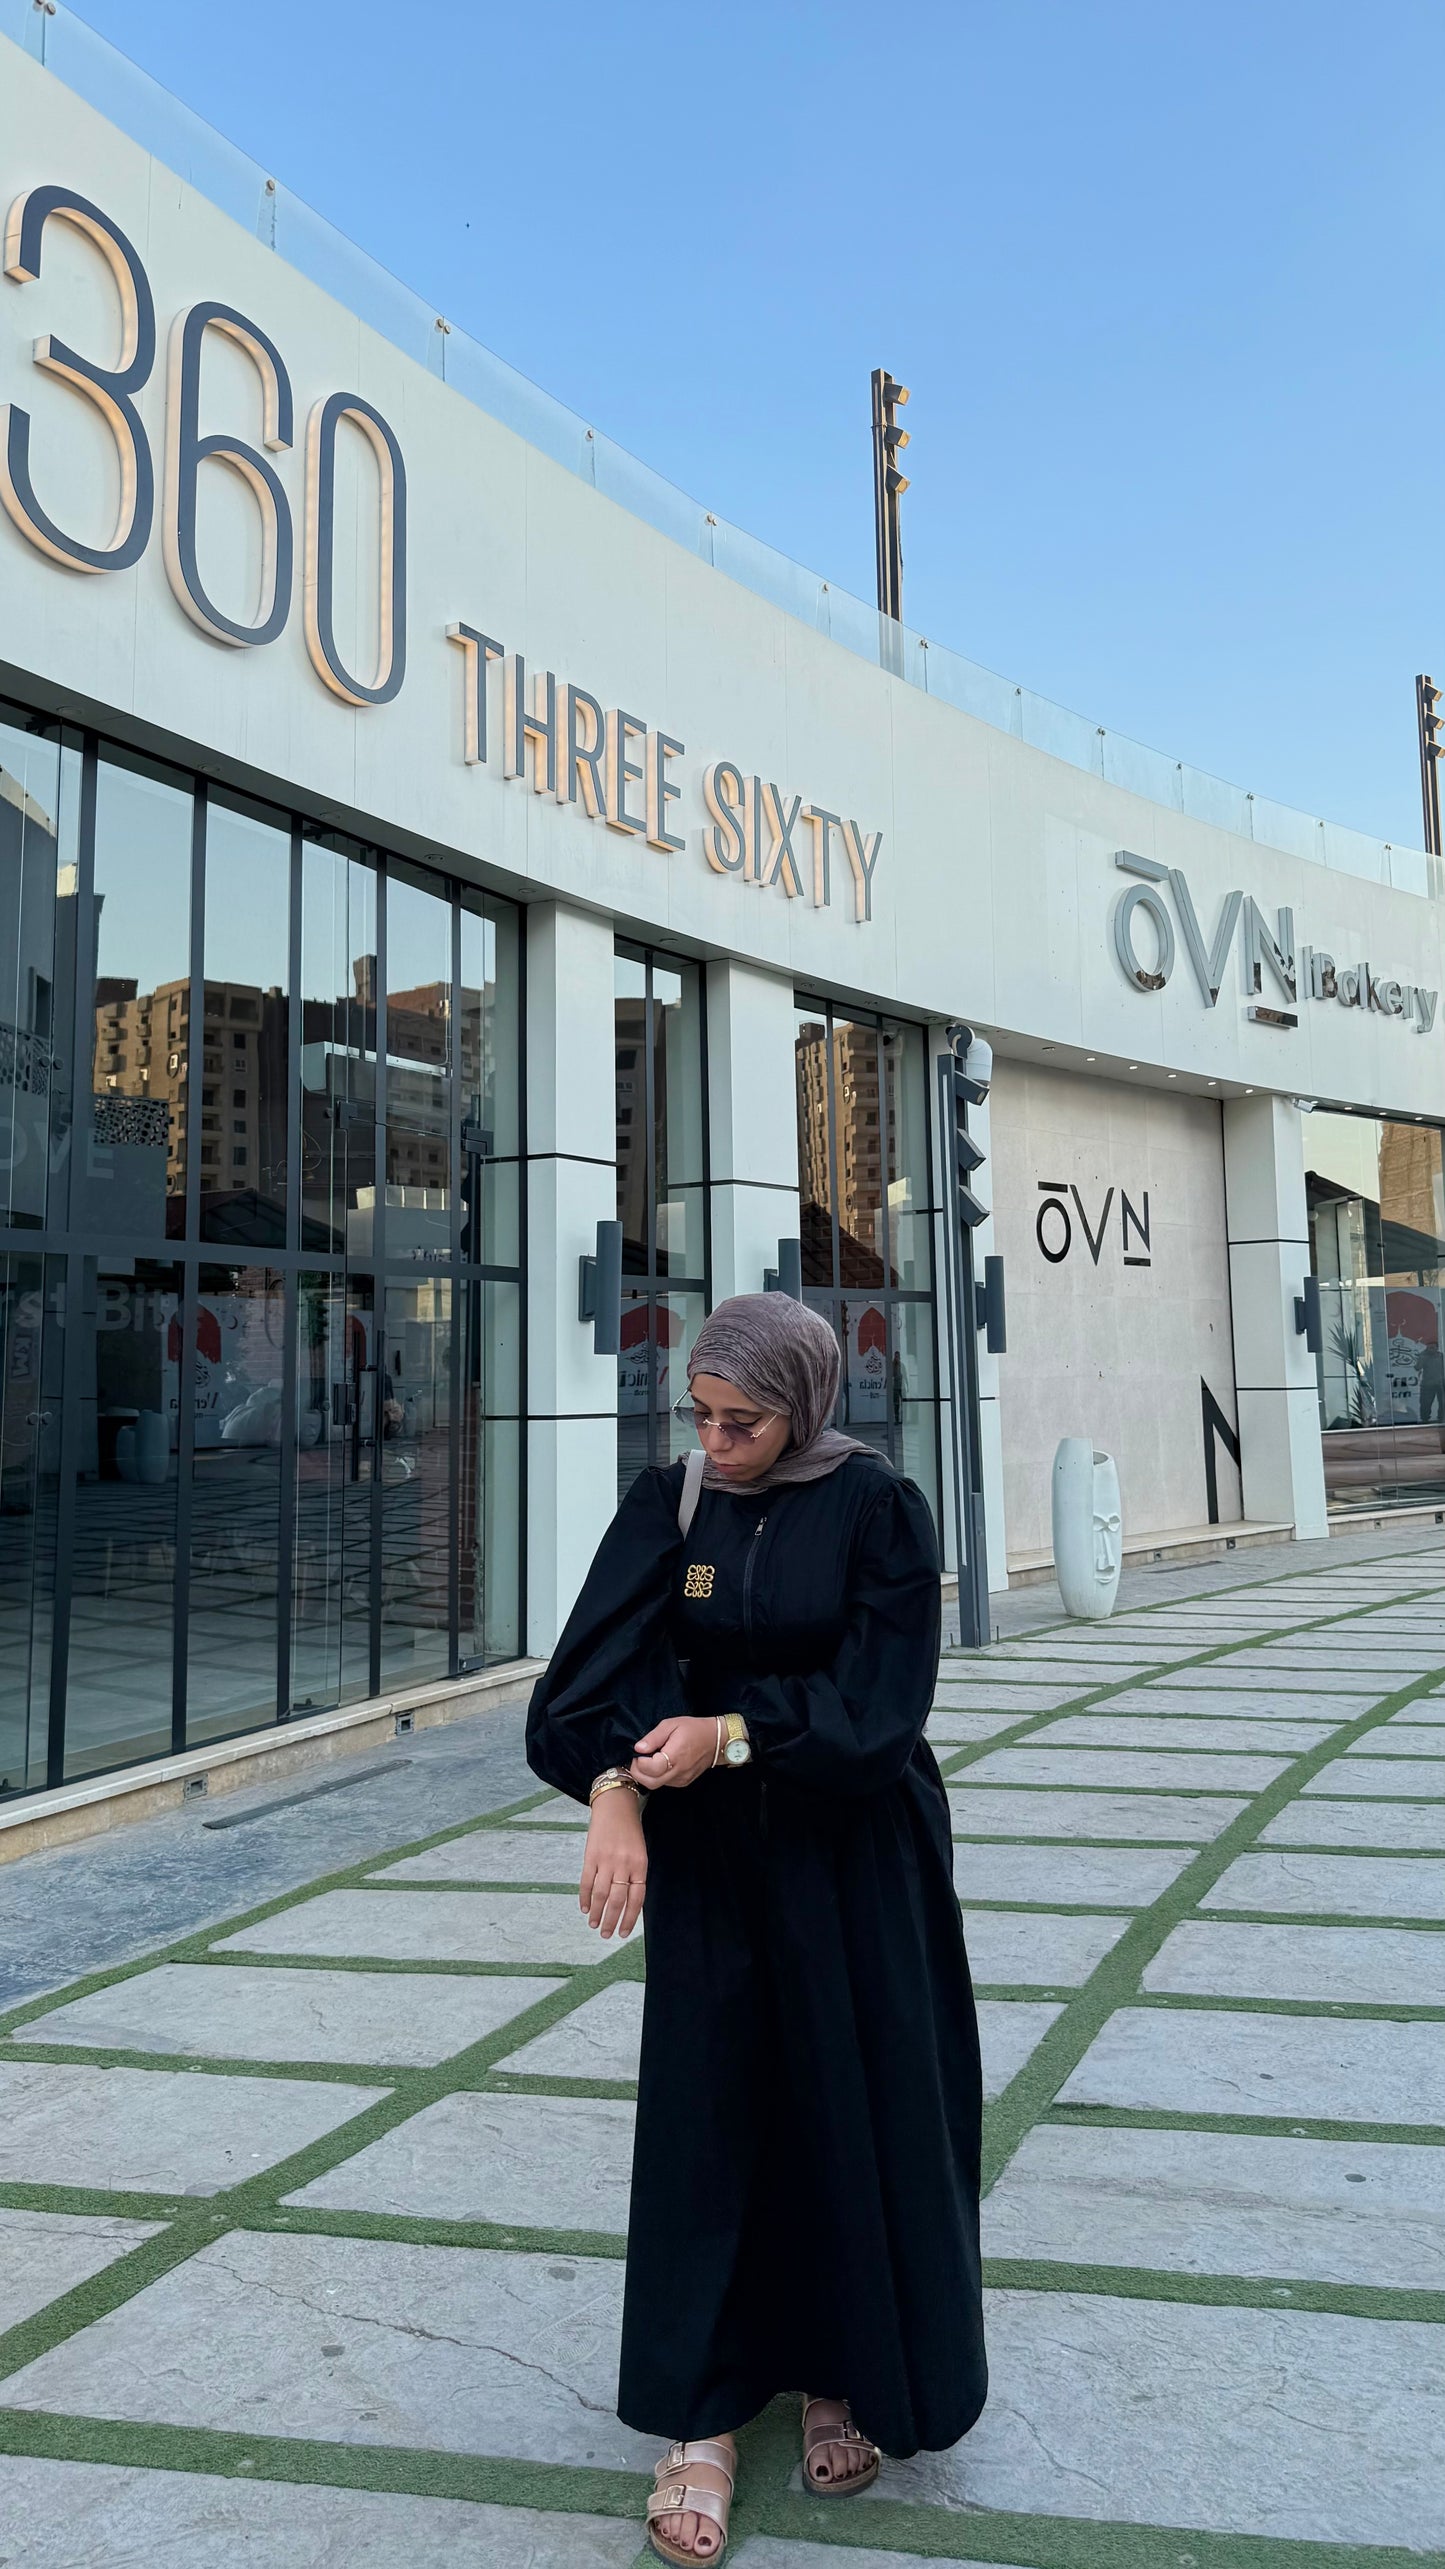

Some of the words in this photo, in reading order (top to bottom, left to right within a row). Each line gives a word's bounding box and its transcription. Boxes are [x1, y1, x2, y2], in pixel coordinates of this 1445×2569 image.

[0, 185, 407, 707] 360
[446, 622, 685, 853] THREE
[703, 760, 884, 924] SIXTY
